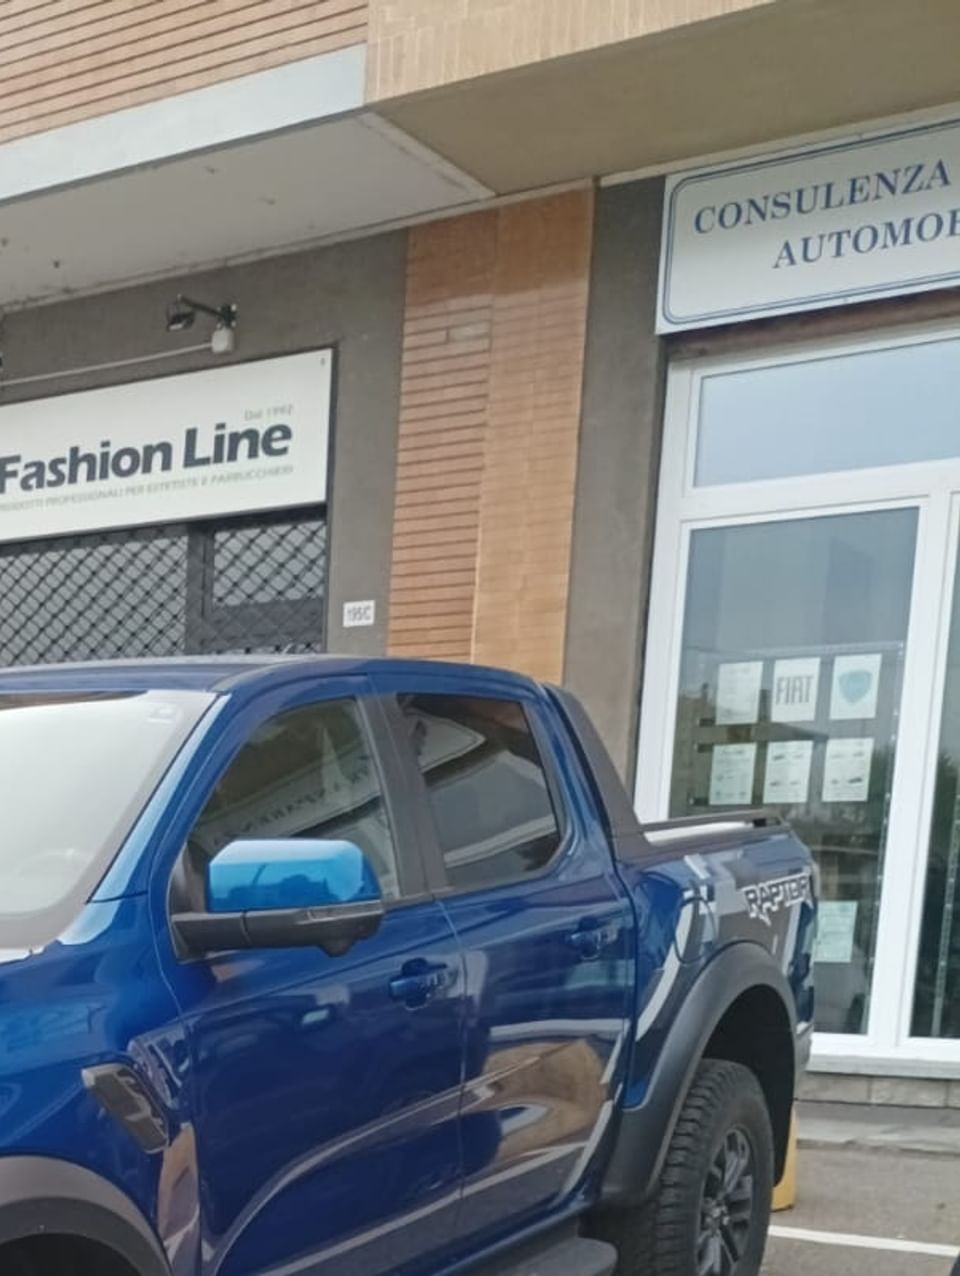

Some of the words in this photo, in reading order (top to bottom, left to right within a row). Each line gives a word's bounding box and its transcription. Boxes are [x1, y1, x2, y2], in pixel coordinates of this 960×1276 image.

[694, 159, 951, 234] CONSULENZA
[183, 422, 293, 469] Line
[125, 483, 145, 496] PER
[775, 674, 814, 705] FIAT
[741, 872, 814, 927] RAPTOR
